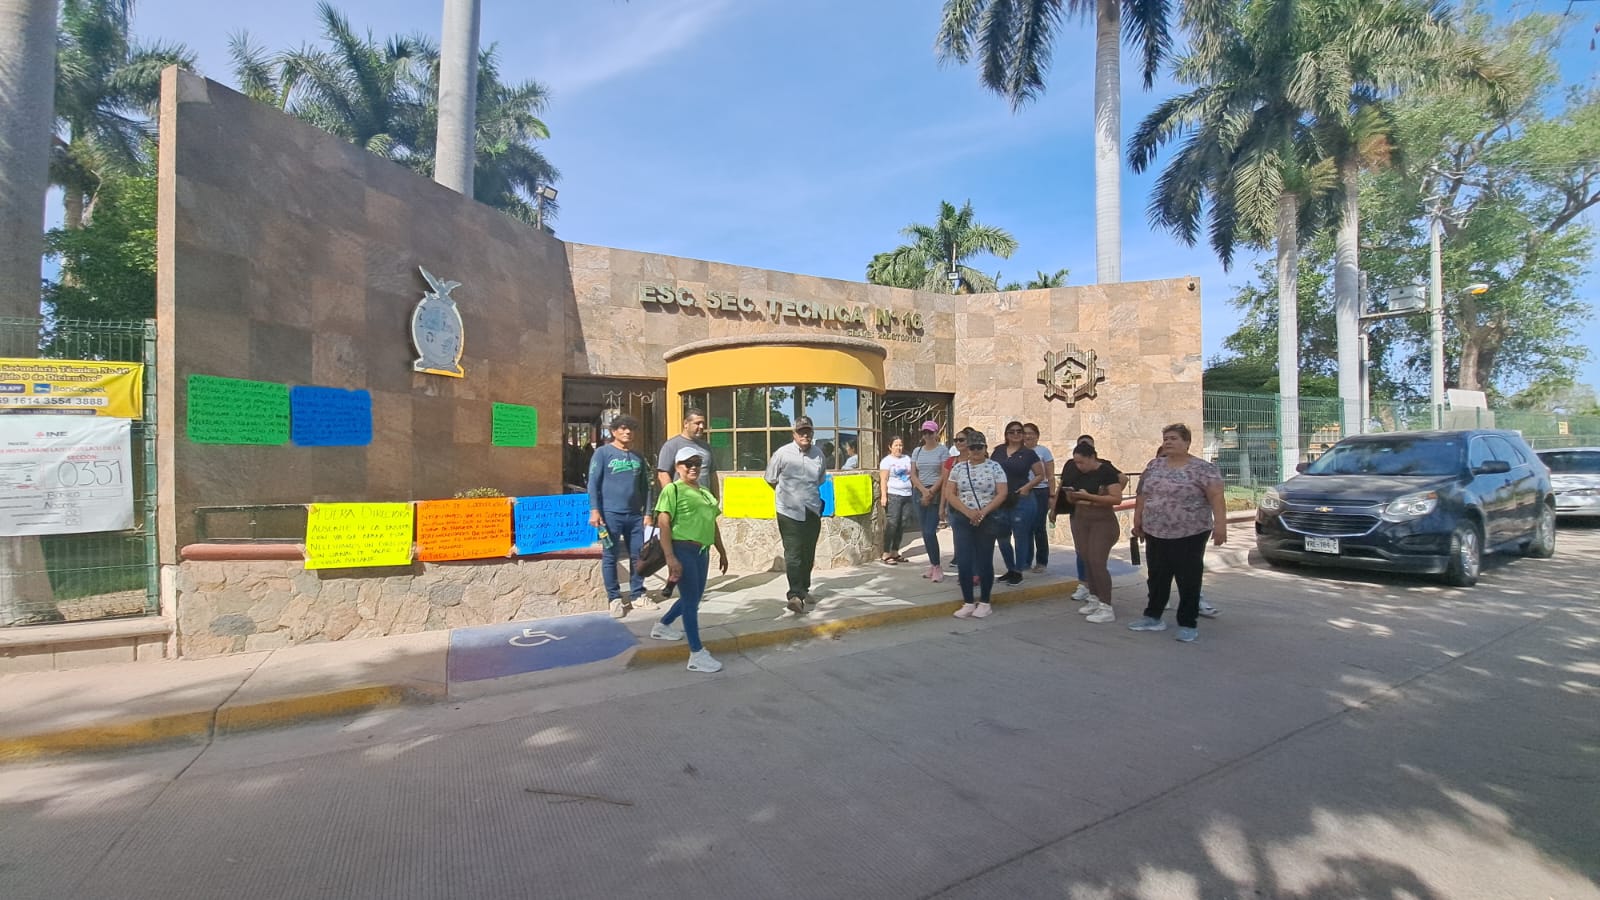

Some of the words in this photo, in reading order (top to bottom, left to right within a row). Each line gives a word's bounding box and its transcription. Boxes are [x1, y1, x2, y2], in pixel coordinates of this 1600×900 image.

[639, 281, 703, 307] ESC.
[766, 296, 865, 323] TECNICA
[903, 311, 924, 330] 16
[2, 364, 57, 374] Secundaria
[0, 373, 20, 382] jido
[44, 397, 72, 405] 3554
[76, 397, 103, 405] 3888
[58, 460, 123, 488] 0351
